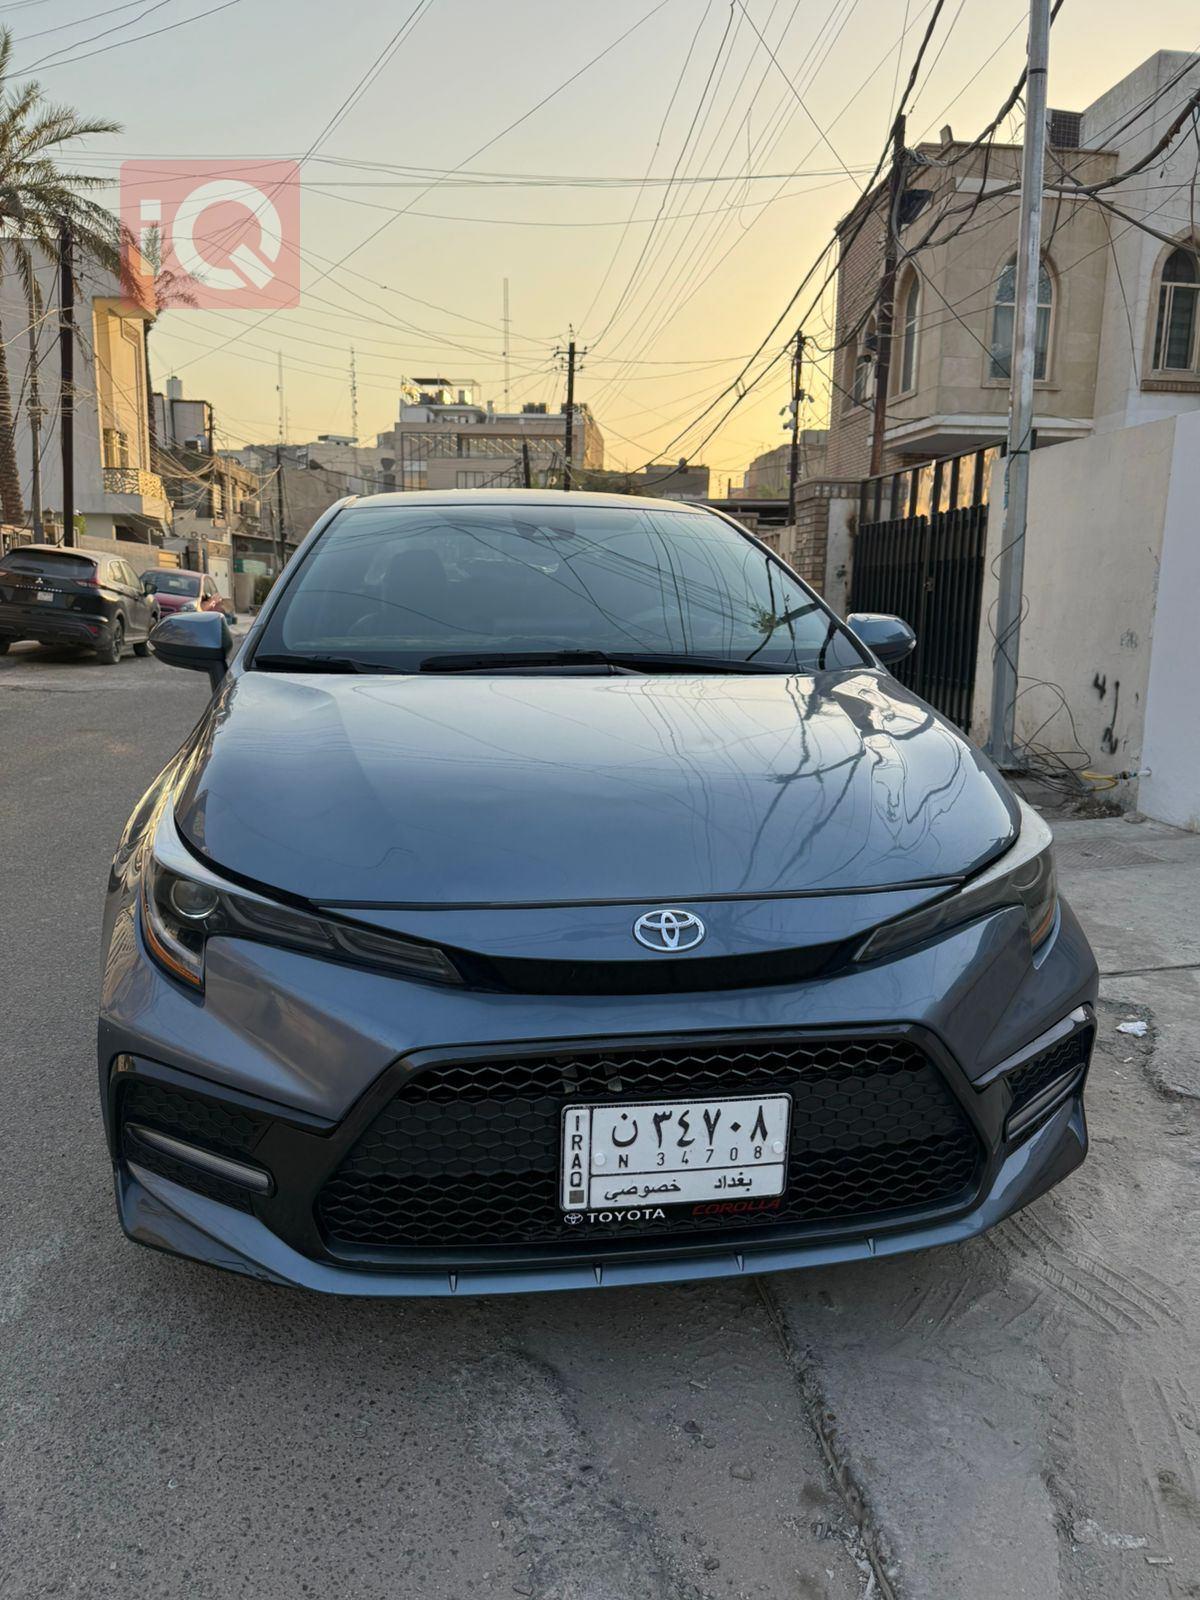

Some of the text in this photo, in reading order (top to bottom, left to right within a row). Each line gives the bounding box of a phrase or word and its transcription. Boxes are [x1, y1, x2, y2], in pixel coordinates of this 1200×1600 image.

[570, 1115, 584, 1188] IRAQ
[604, 1172, 753, 1203] بغداد خصوصي
[587, 1208, 666, 1223] TOYOTA
[692, 1199, 783, 1216] COROLLA
